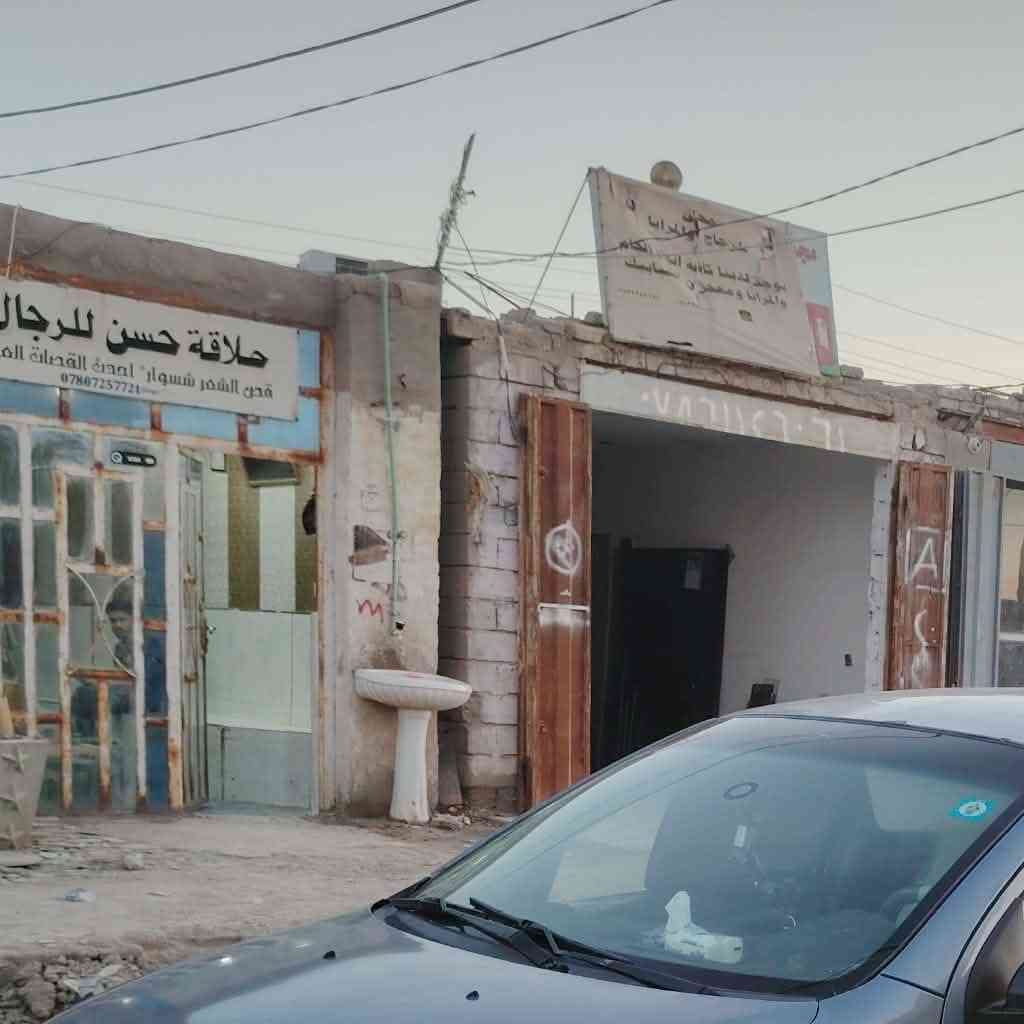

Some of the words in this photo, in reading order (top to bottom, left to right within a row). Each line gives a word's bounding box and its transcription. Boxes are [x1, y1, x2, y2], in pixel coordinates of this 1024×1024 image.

[0, 292, 95, 341] للرجال
[106, 318, 183, 356] حسن
[187, 328, 270, 369] حلاقة
